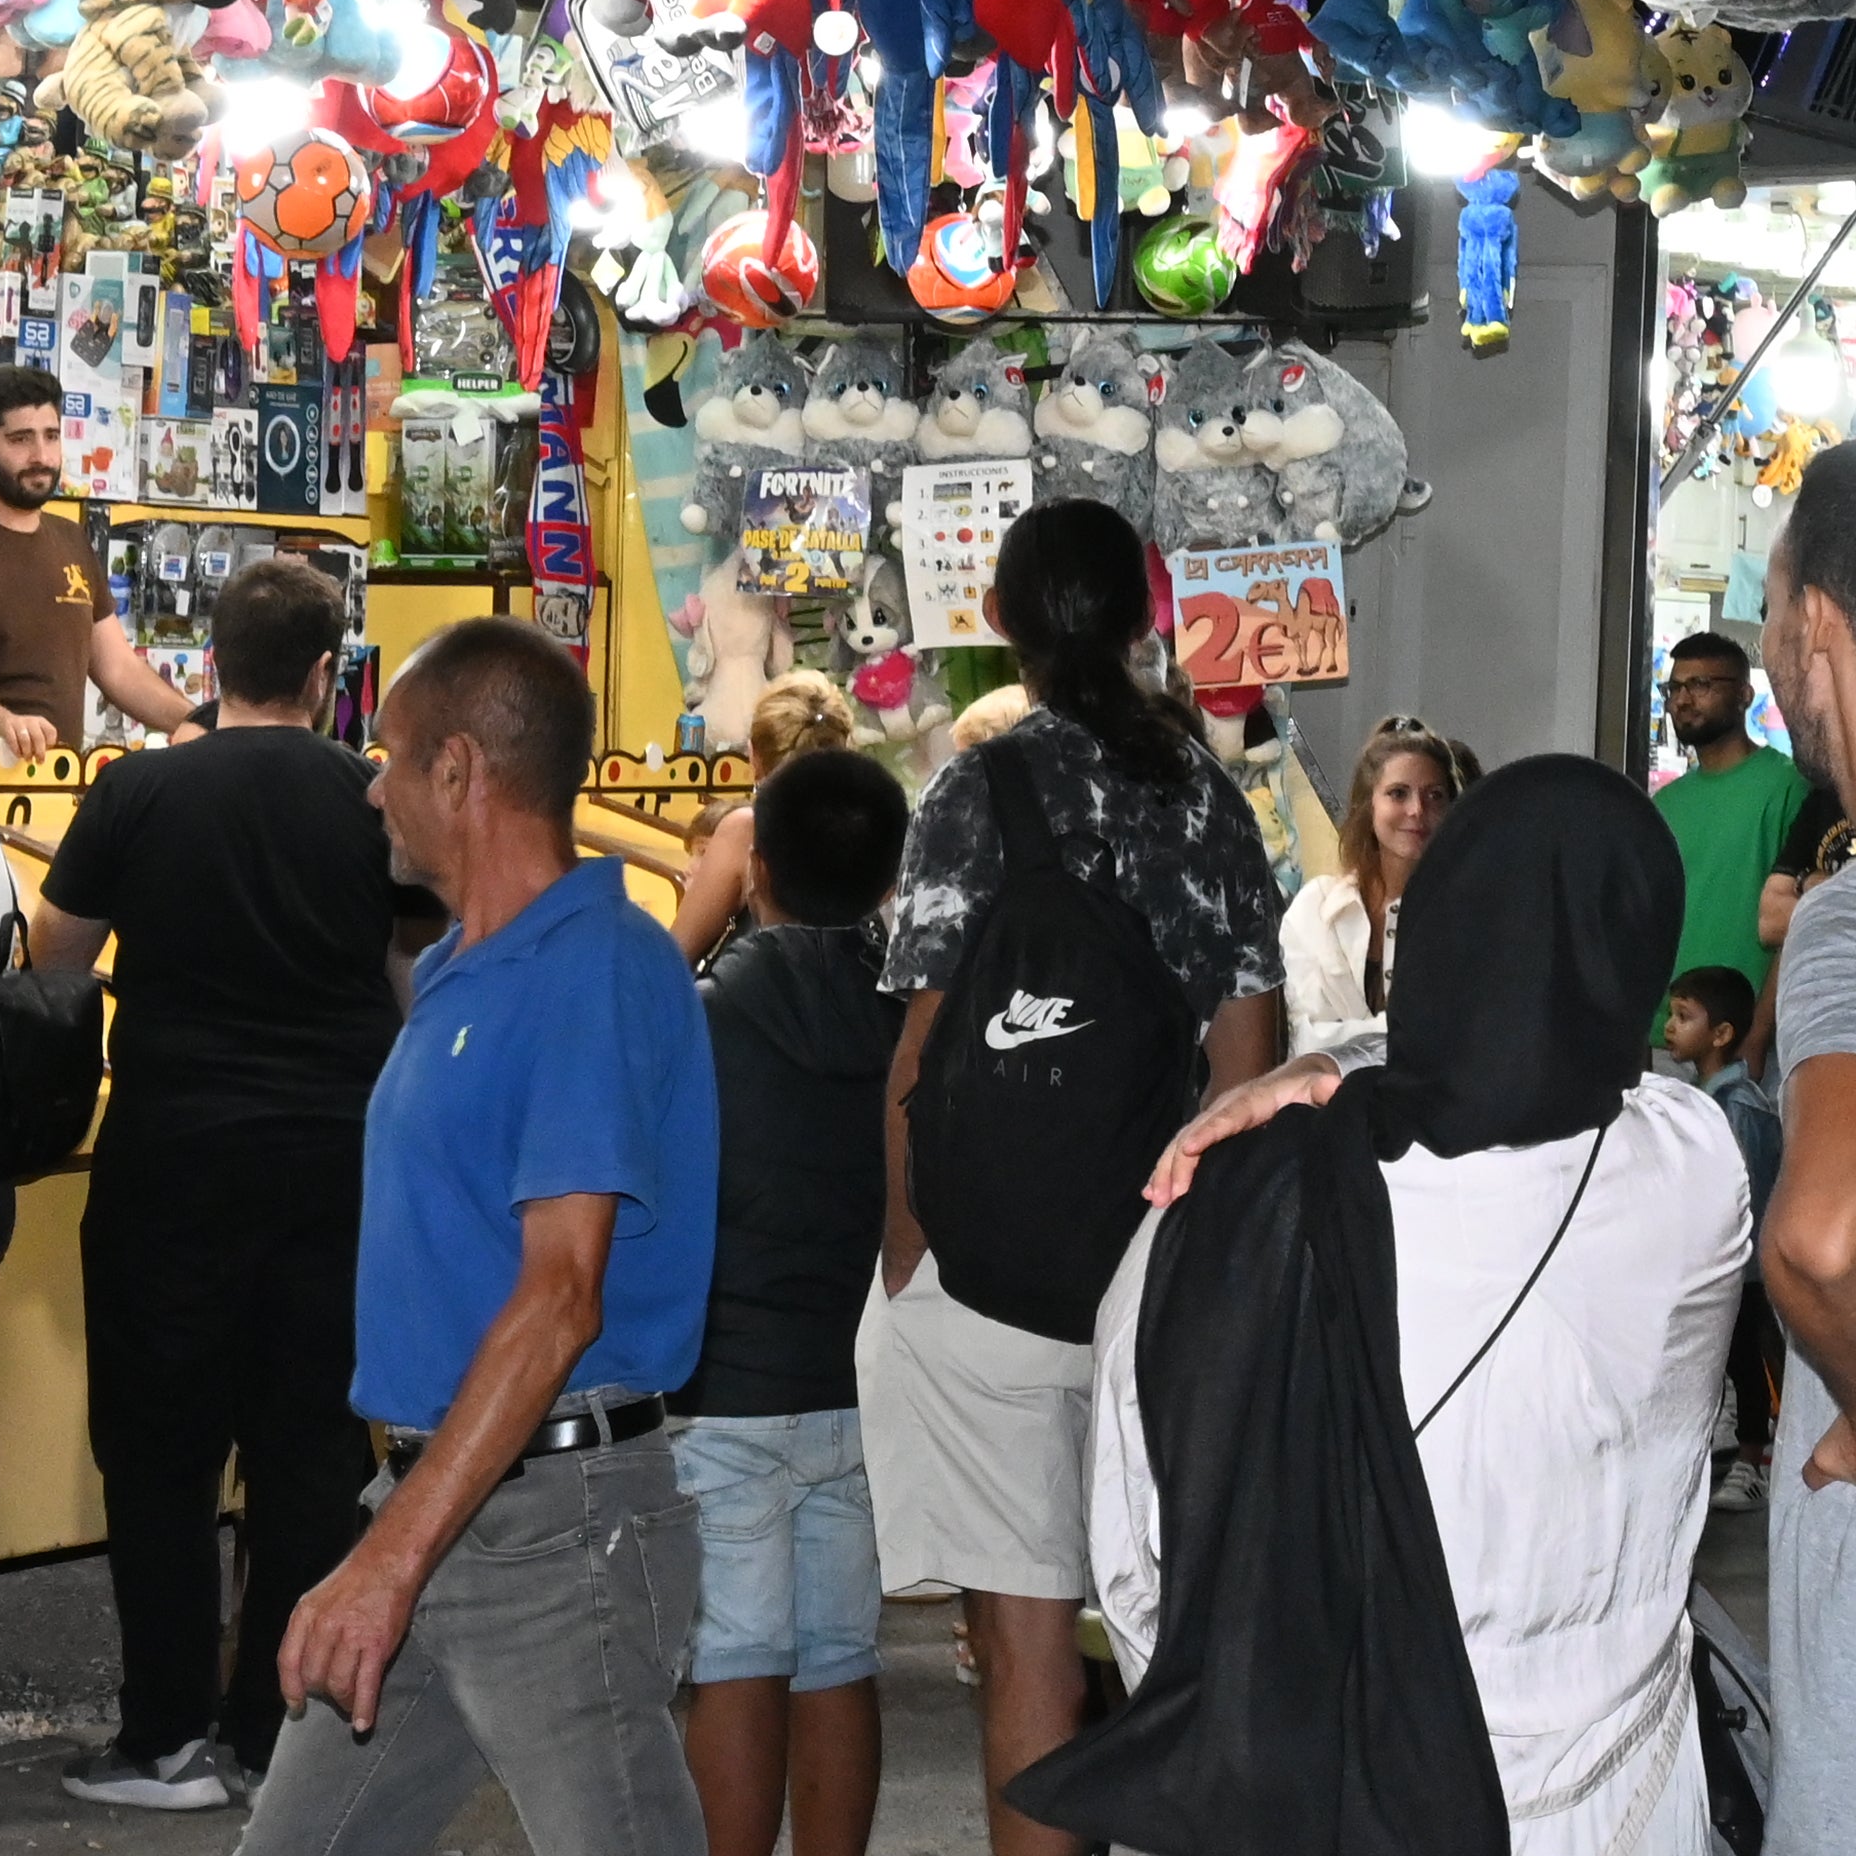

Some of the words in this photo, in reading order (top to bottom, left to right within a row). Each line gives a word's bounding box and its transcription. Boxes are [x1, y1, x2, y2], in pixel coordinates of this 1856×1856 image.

[457, 377, 498, 390] HELPER
[760, 471, 857, 499] FORTNITE
[742, 530, 776, 549] PASE
[785, 562, 810, 593] 2
[1184, 556, 1209, 581] LA
[1215, 547, 1329, 577] CARRERA
[1006, 990, 1075, 1032] NIKE
[993, 1058, 1063, 1088] AIR
